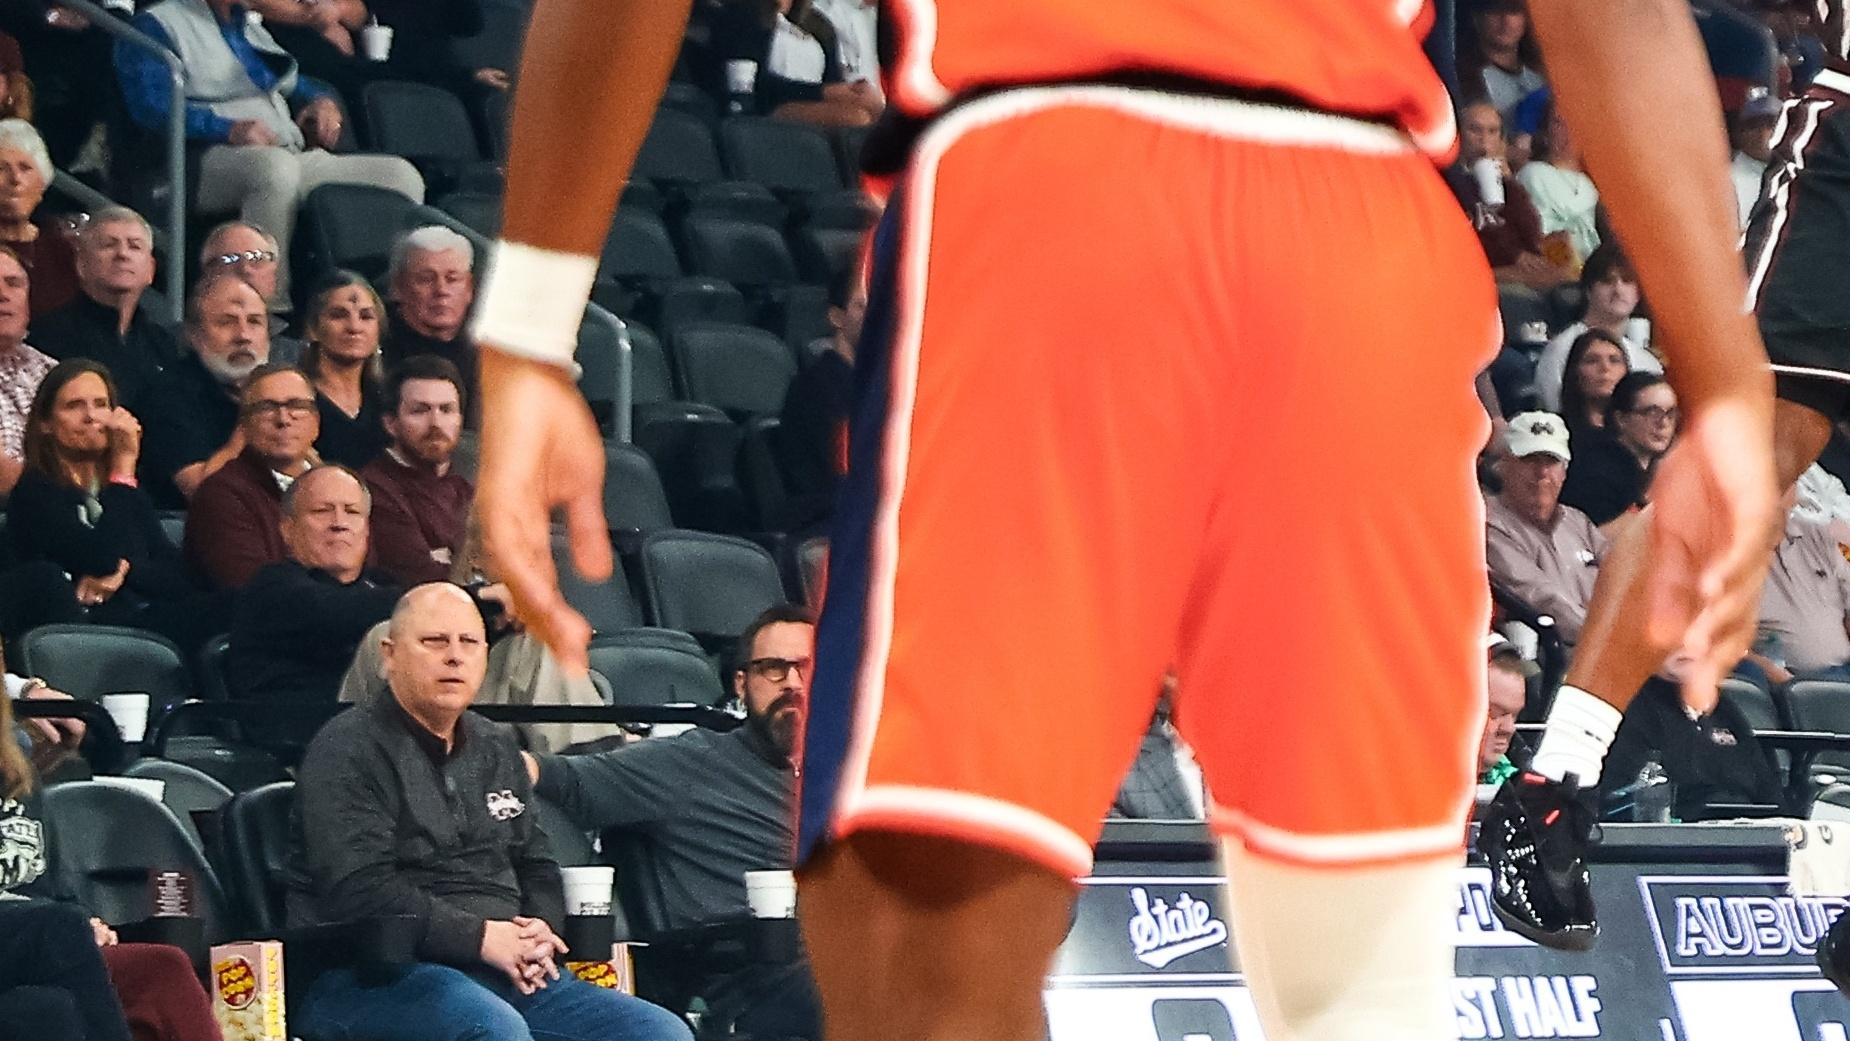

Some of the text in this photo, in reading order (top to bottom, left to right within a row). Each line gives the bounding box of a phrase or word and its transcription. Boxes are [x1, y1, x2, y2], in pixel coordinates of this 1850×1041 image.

[1129, 886, 1229, 969] State
[1455, 974, 1603, 1039] ST HALF
